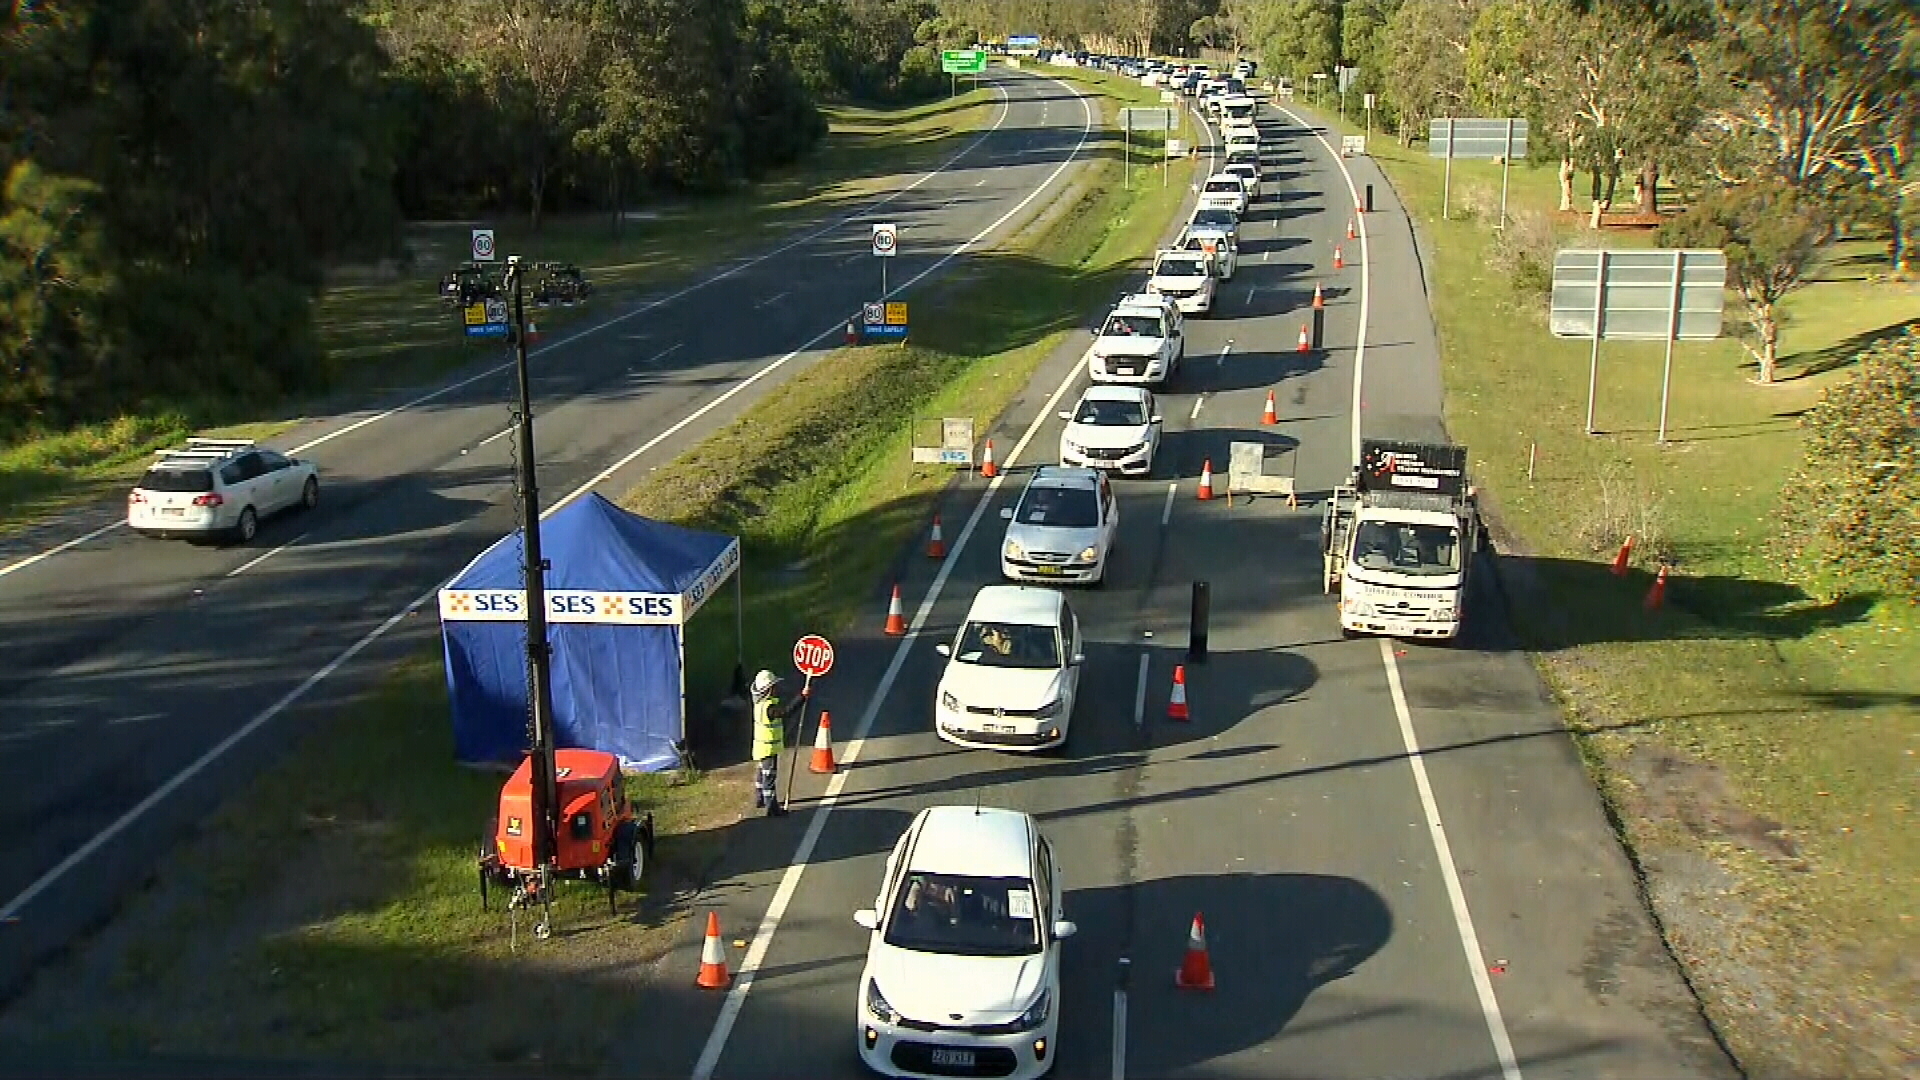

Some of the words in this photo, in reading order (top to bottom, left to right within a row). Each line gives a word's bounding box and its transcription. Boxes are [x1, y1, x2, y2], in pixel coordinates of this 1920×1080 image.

[475, 593, 519, 612] SES
[551, 595, 595, 614] SES
[628, 597, 673, 615] SES
[796, 643, 830, 669] STOP
